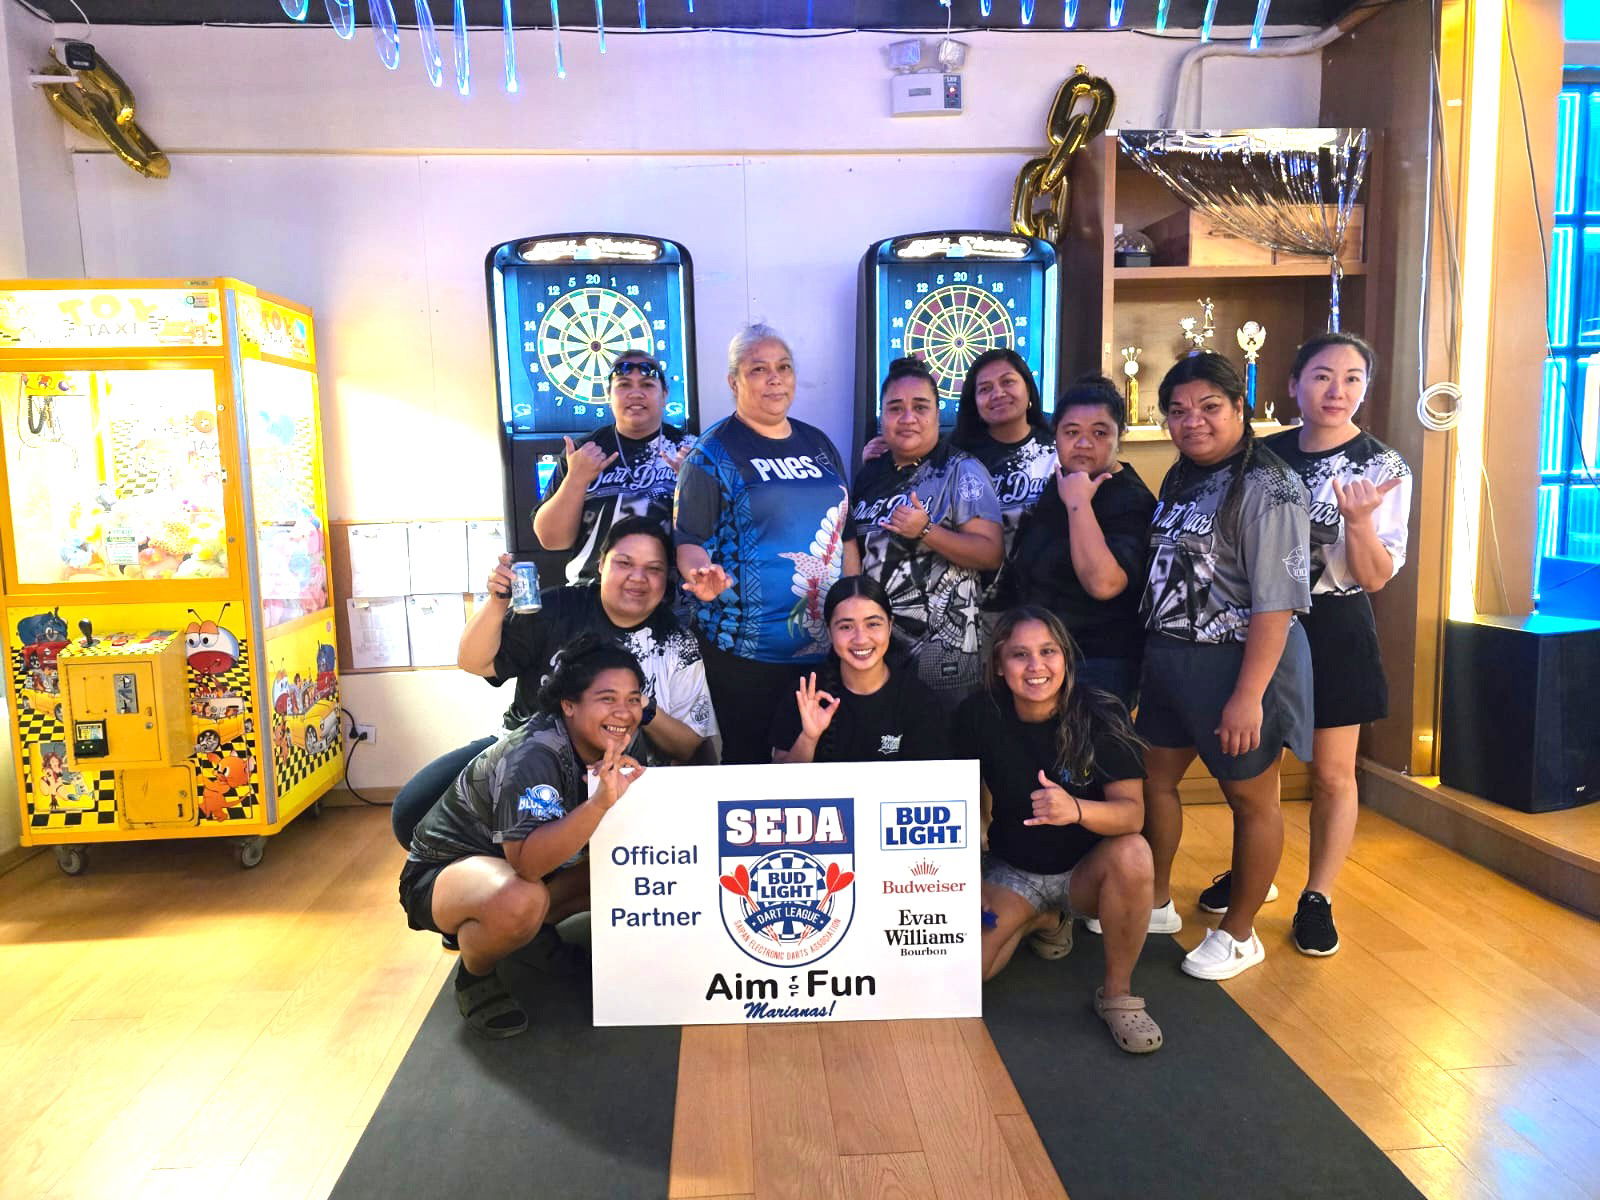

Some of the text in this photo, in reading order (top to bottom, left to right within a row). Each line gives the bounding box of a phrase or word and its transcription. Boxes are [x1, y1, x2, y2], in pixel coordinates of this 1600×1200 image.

[568, 276, 577, 288] 5
[585, 273, 601, 285] 20
[610, 276, 617, 287] 1
[936, 274, 945, 285] 5
[953, 271, 968, 282] 20
[977, 274, 983, 285] 1
[547, 285, 561, 296] 12
[916, 282, 929, 293] 12
[991, 282, 1004, 293] 18
[643, 301, 653, 312] 4
[1006, 297, 1016, 309] 4
[57, 294, 158, 327] TOY
[85, 322, 138, 337] TAXI
[523, 320, 537, 331] 14
[523, 341, 536, 352] 11
[554, 396, 564, 407] 7
[573, 404, 587, 415] 19
[896, 806, 951, 825] BUD
[725, 806, 847, 846] SEDA
[886, 825, 961, 845] LIGHT
[611, 845, 698, 866] Official
[768, 871, 806, 885] BUD
[634, 876, 678, 896] Bar
[761, 885, 814, 899] LIGHT
[882, 880, 966, 894] Budweiser
[611, 907, 702, 927] Partner
[756, 907, 821, 925] DART LEAGUE
[898, 909, 948, 926] Evan
[733, 918, 842, 961] SAIPAN ELECTRONIC DARTS ASSOCIATION
[884, 929, 965, 946] Williams
[900, 948, 947, 957] Bourbon
[705, 973, 778, 1000] Aim
[807, 970, 876, 997] Fun
[743, 1000, 837, 1019] Marianas!
